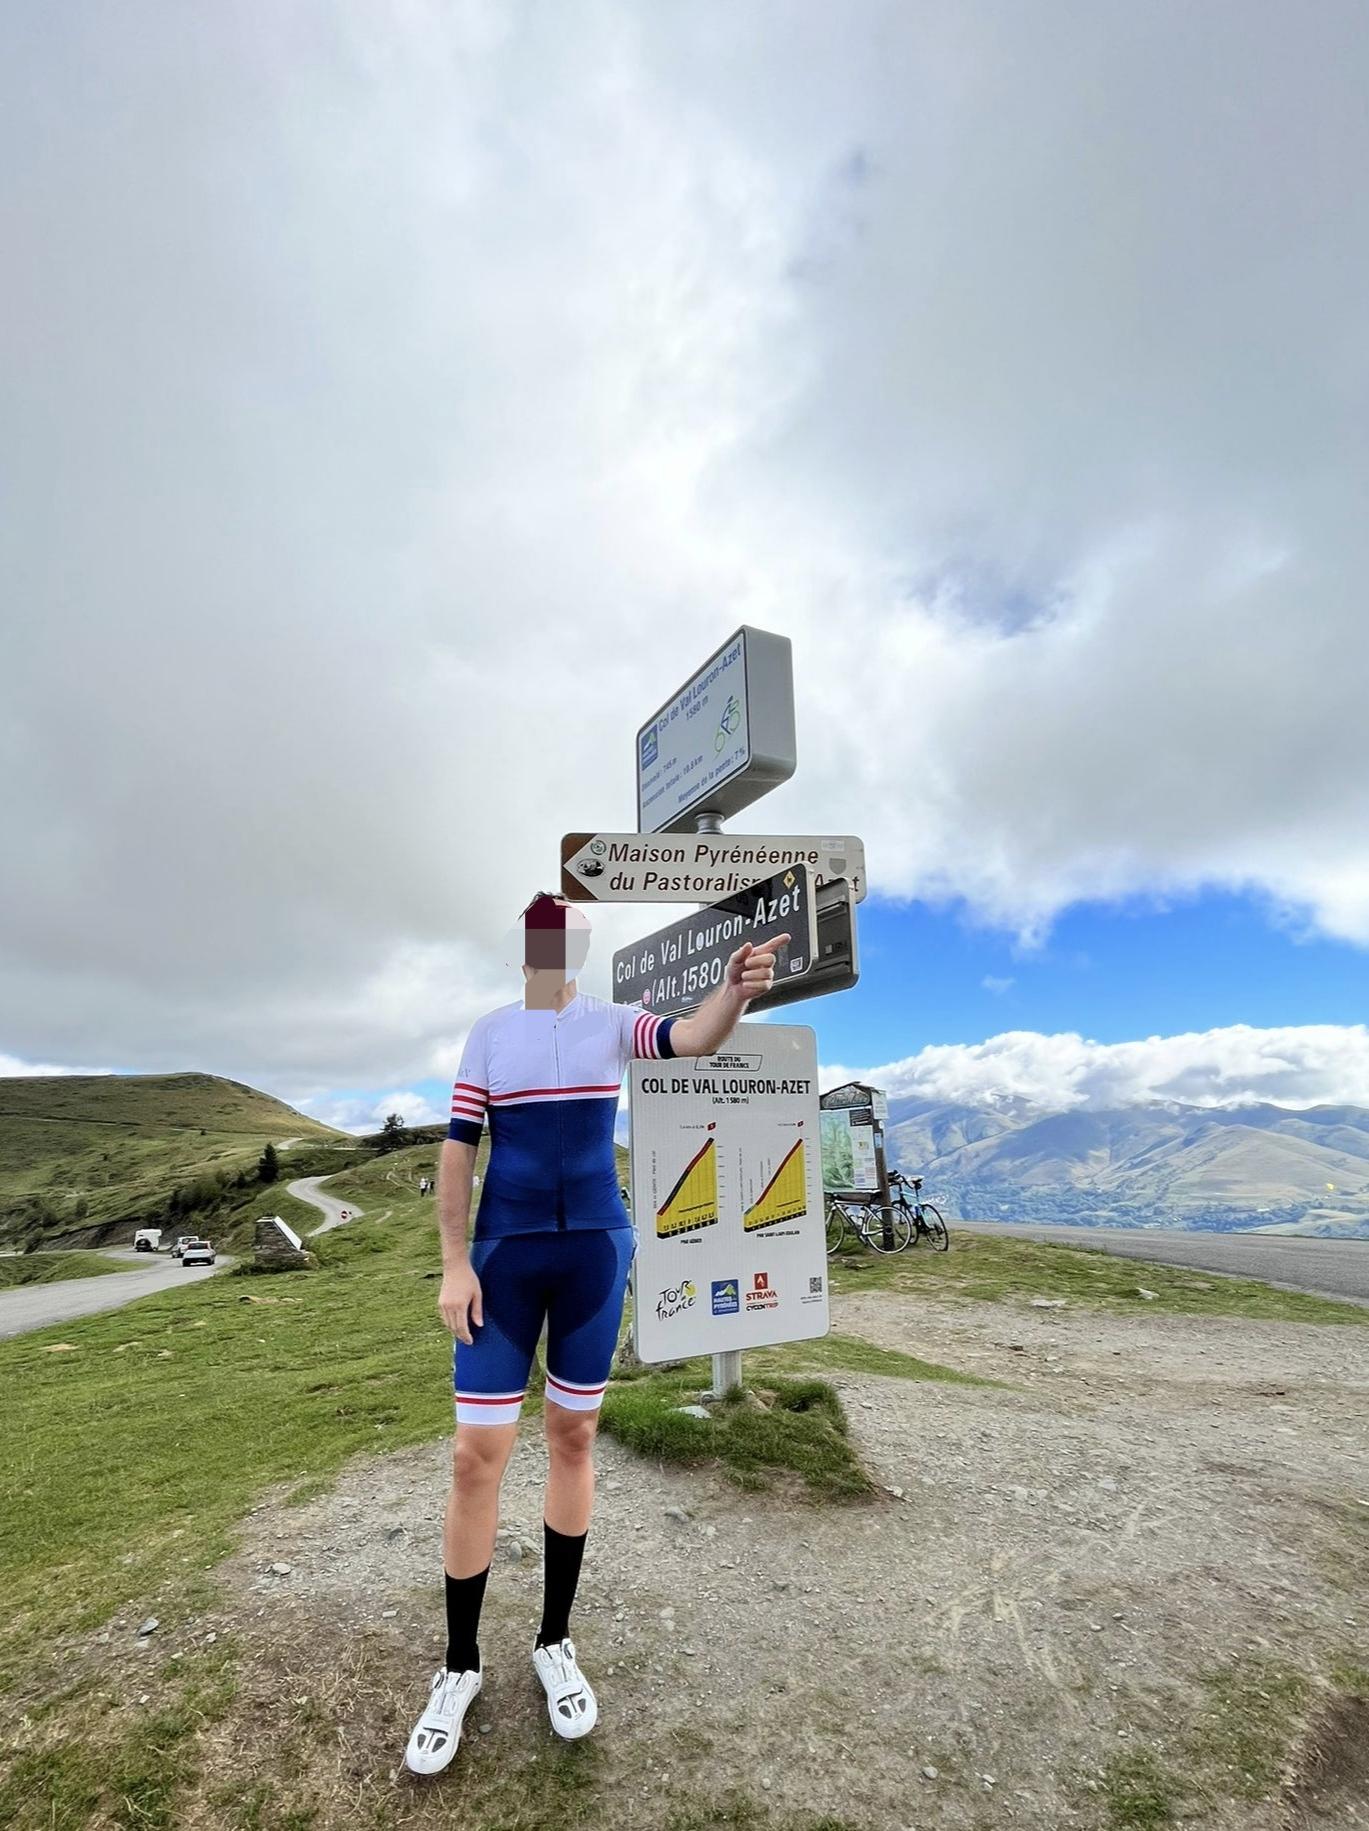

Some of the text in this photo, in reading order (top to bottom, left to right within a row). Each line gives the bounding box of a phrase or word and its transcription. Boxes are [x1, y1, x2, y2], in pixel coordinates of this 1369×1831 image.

[659, 643, 741, 732] Col de Val Louron-Azet
[687, 701, 701, 720] 1580
[608, 844, 685, 862] Maison
[694, 845, 819, 867] Pyrénéenne
[609, 871, 634, 891] du
[617, 885, 801, 983] Col de Val Louron-Azet
[641, 1078, 811, 1095] COL DE VAL LOURON-AZET
[746, 1290, 778, 1301] STRAVA
